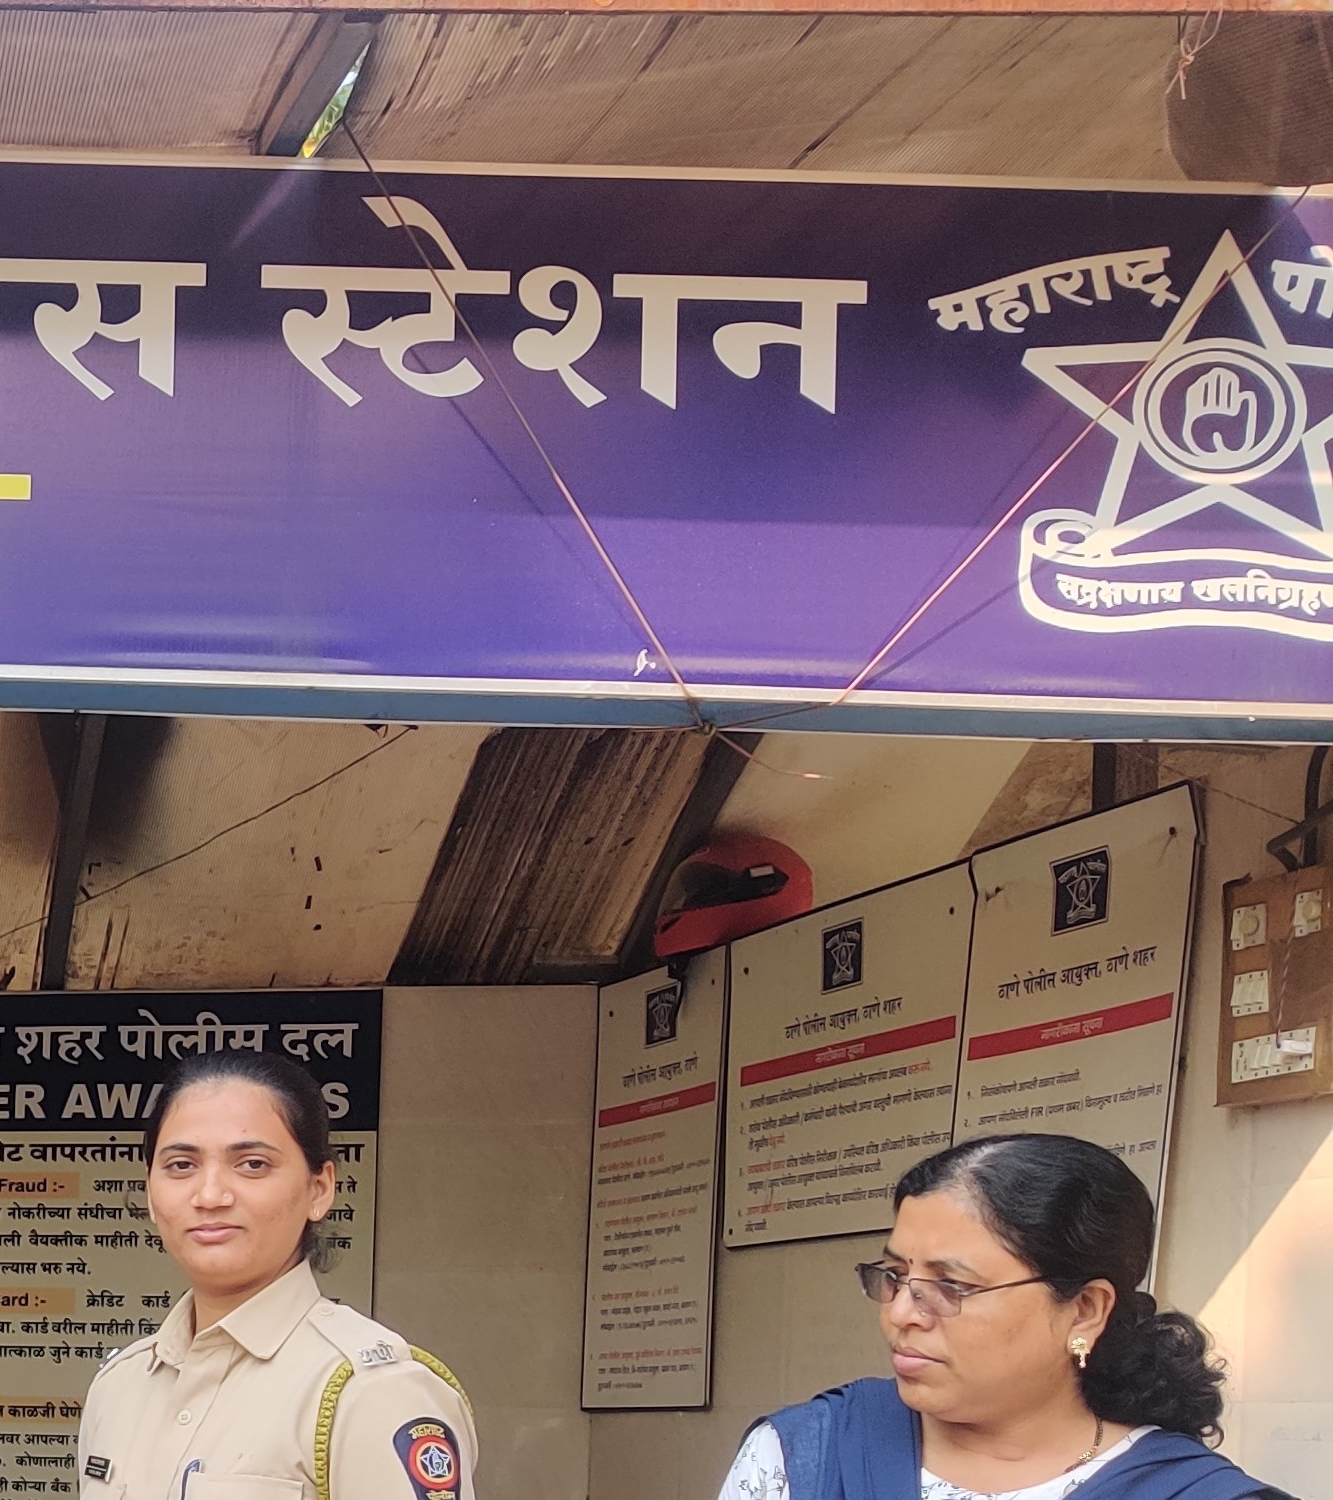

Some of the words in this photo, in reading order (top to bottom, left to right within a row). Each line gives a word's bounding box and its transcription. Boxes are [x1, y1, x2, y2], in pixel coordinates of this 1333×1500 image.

[928, 246, 1181, 333] महाराष्ट्र
[260, 196, 868, 415] स्टेशन
[1132, 946, 1157, 970] शहर
[883, 997, 903, 1014] शहर
[15, 1025, 107, 1065] शहर
[118, 1008, 269, 1060] पोलीस
[280, 1023, 359, 1062] दल
[93, 1179, 124, 1193] अशा
[7, 1203, 71, 1222] नोकरीच्या
[77, 1203, 123, 1221] संधीचा
[94, 1229, 138, 1248] माहीती
[66, 1257, 91, 1275] नये.
[86, 1289, 125, 1308] क्रेडिट
[141, 1289, 171, 1308] कार्ड
[21, 1316, 49, 1334] कार्ड
[52, 1316, 86, 1335] वरील
[90, 1316, 134, 1335] माहीती
[49, 1341, 71, 1364] जुने
[74, 1341, 104, 1359] कार्ड
[7, 1399, 56, 1419] काळजी
[24, 1432, 70, 1446] आपल्या
[15, 1452, 75, 1469] कोणालाही
